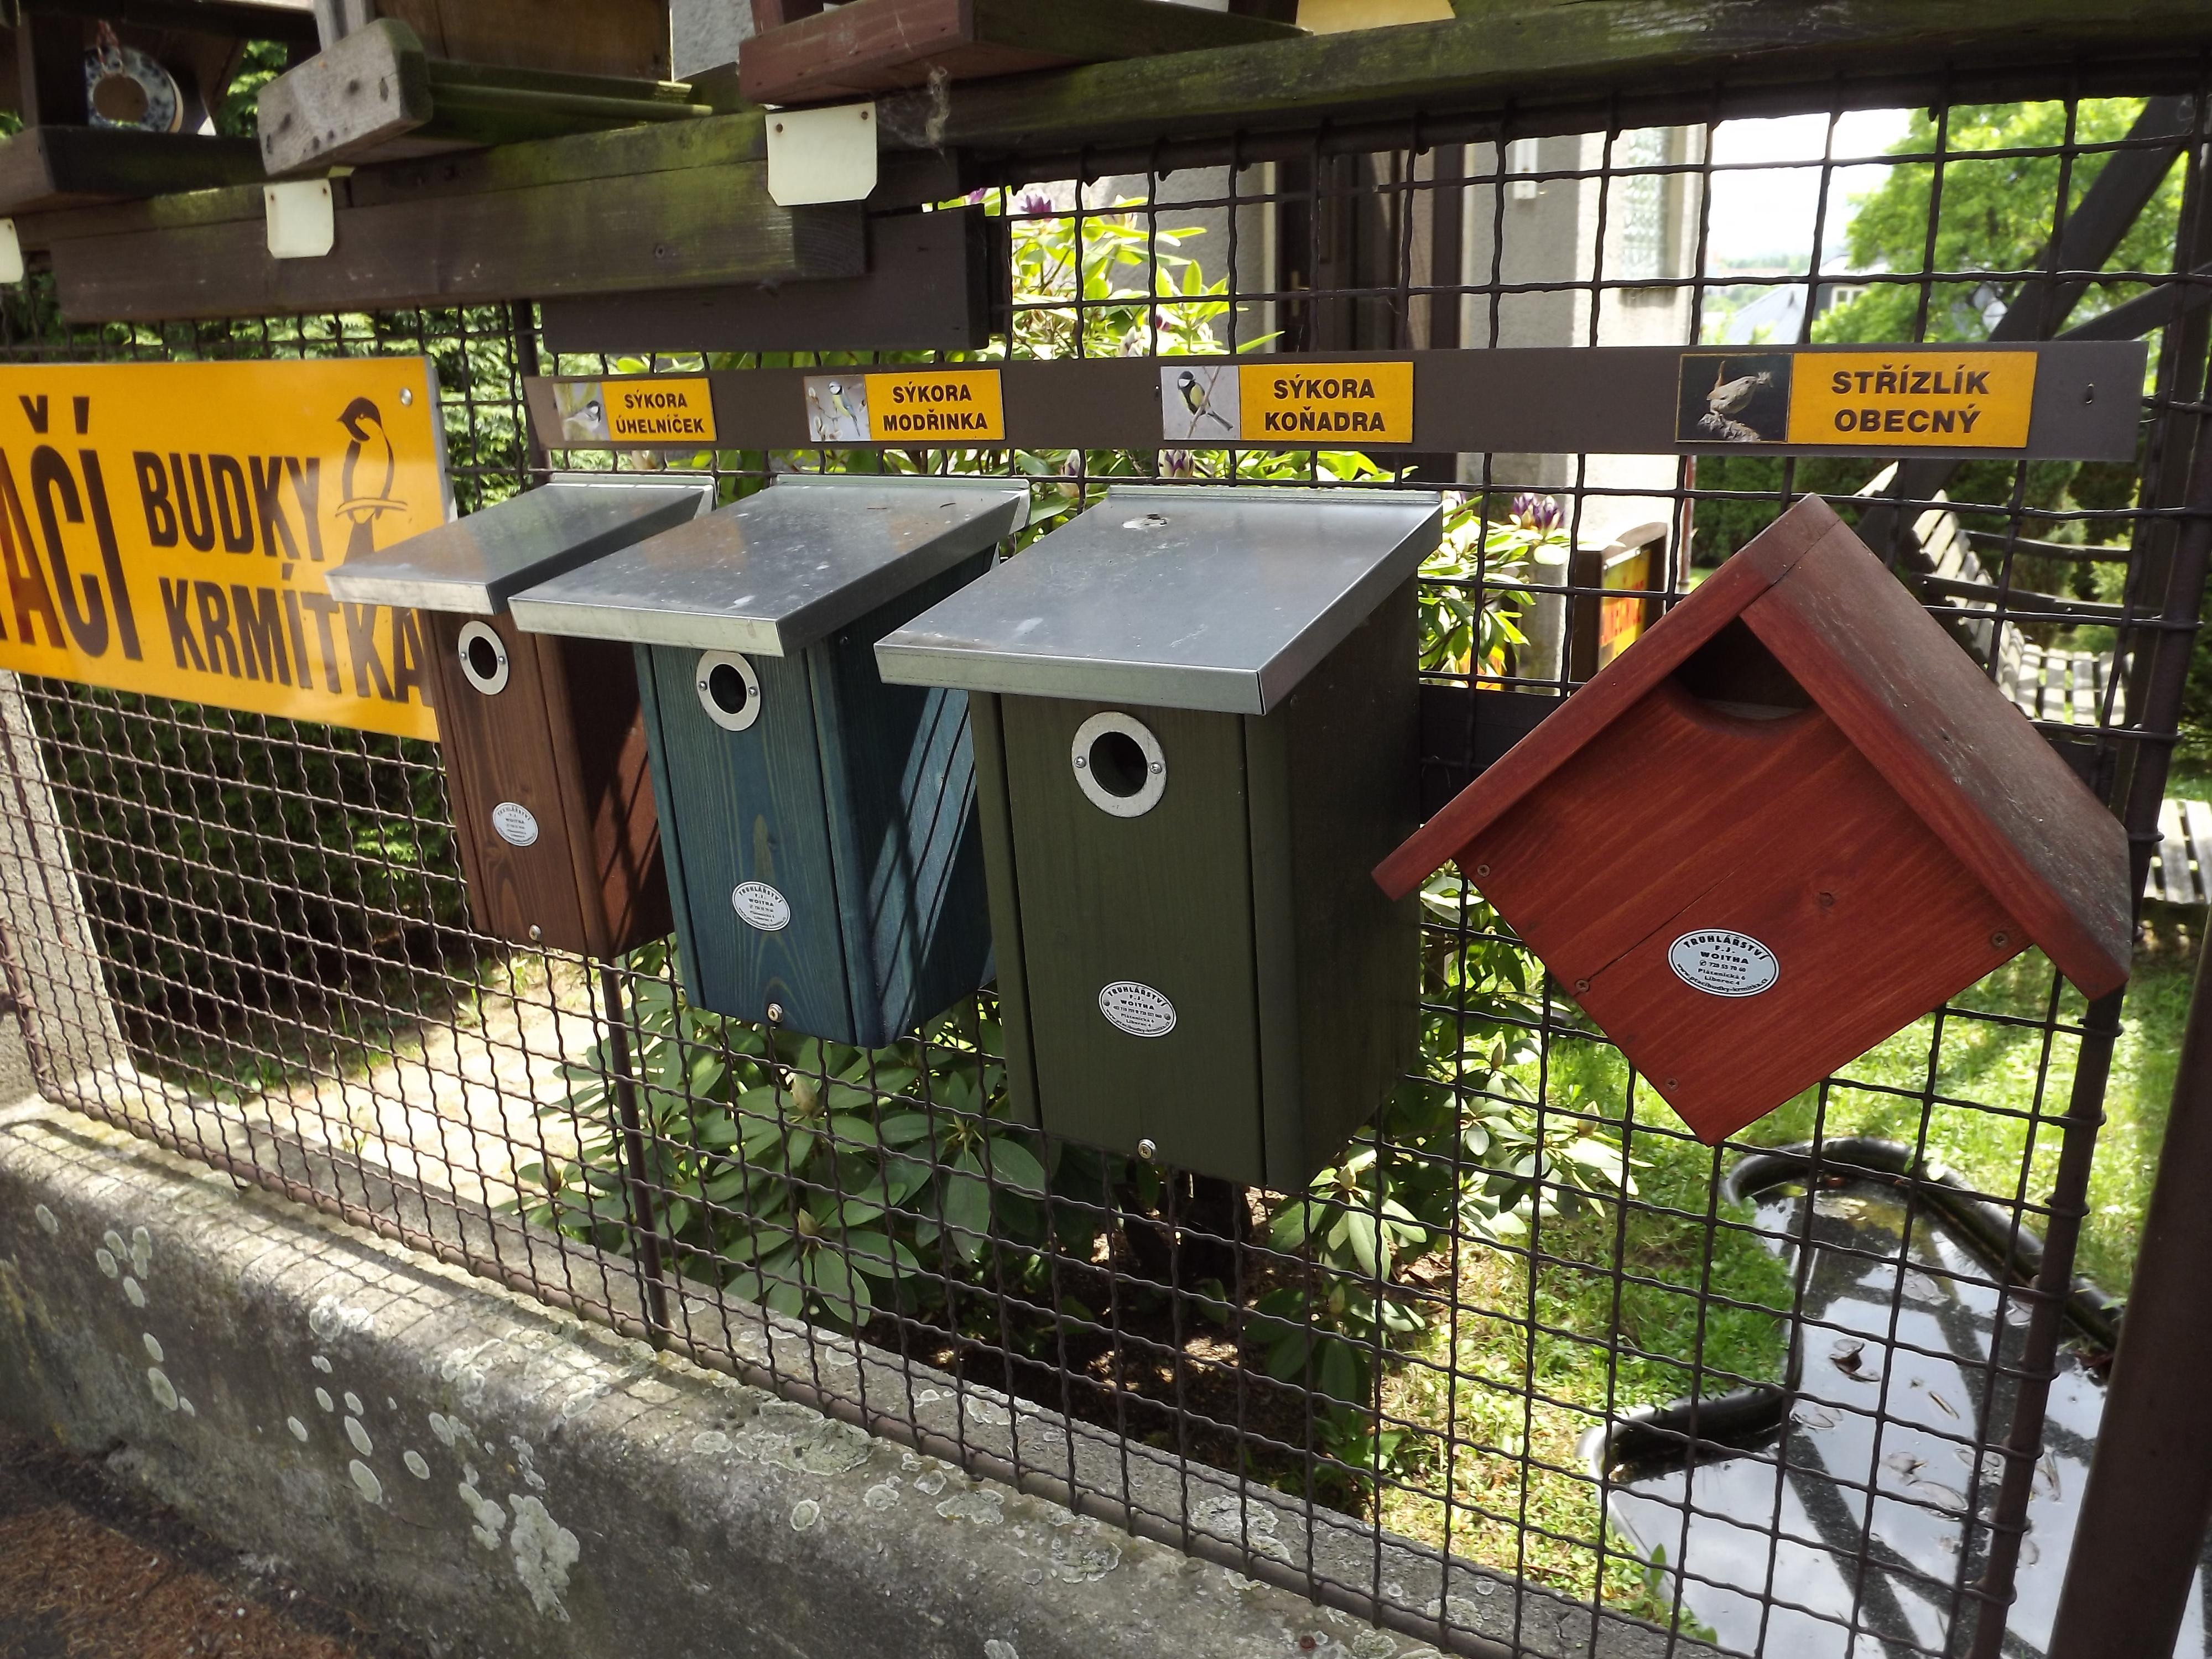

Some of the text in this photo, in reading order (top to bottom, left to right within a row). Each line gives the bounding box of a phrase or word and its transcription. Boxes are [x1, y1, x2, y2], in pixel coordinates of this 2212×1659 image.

[892, 380, 972, 403] SÝKORA
[1273, 374, 1376, 399] SÝKORA
[1831, 363, 1990, 395] STŘÍZLÍK
[624, 389, 688, 408] SÝKORA
[616, 411, 705, 434] ÚHELNÍČEK
[883, 408, 988, 431] MODŘINKA
[1265, 406, 1386, 432] KOŇADRA
[1834, 403, 1981, 433] OBECNÝ
[0, 394, 326, 661] AČÍ BUDKY
[159, 563, 434, 708] KRMÍTKA
[1683, 935, 1769, 961] TRUHLÁŘSTVÍ
[1700, 951, 1749, 964] WOITHA
[1120, 999, 1155, 1010] WOITHA
